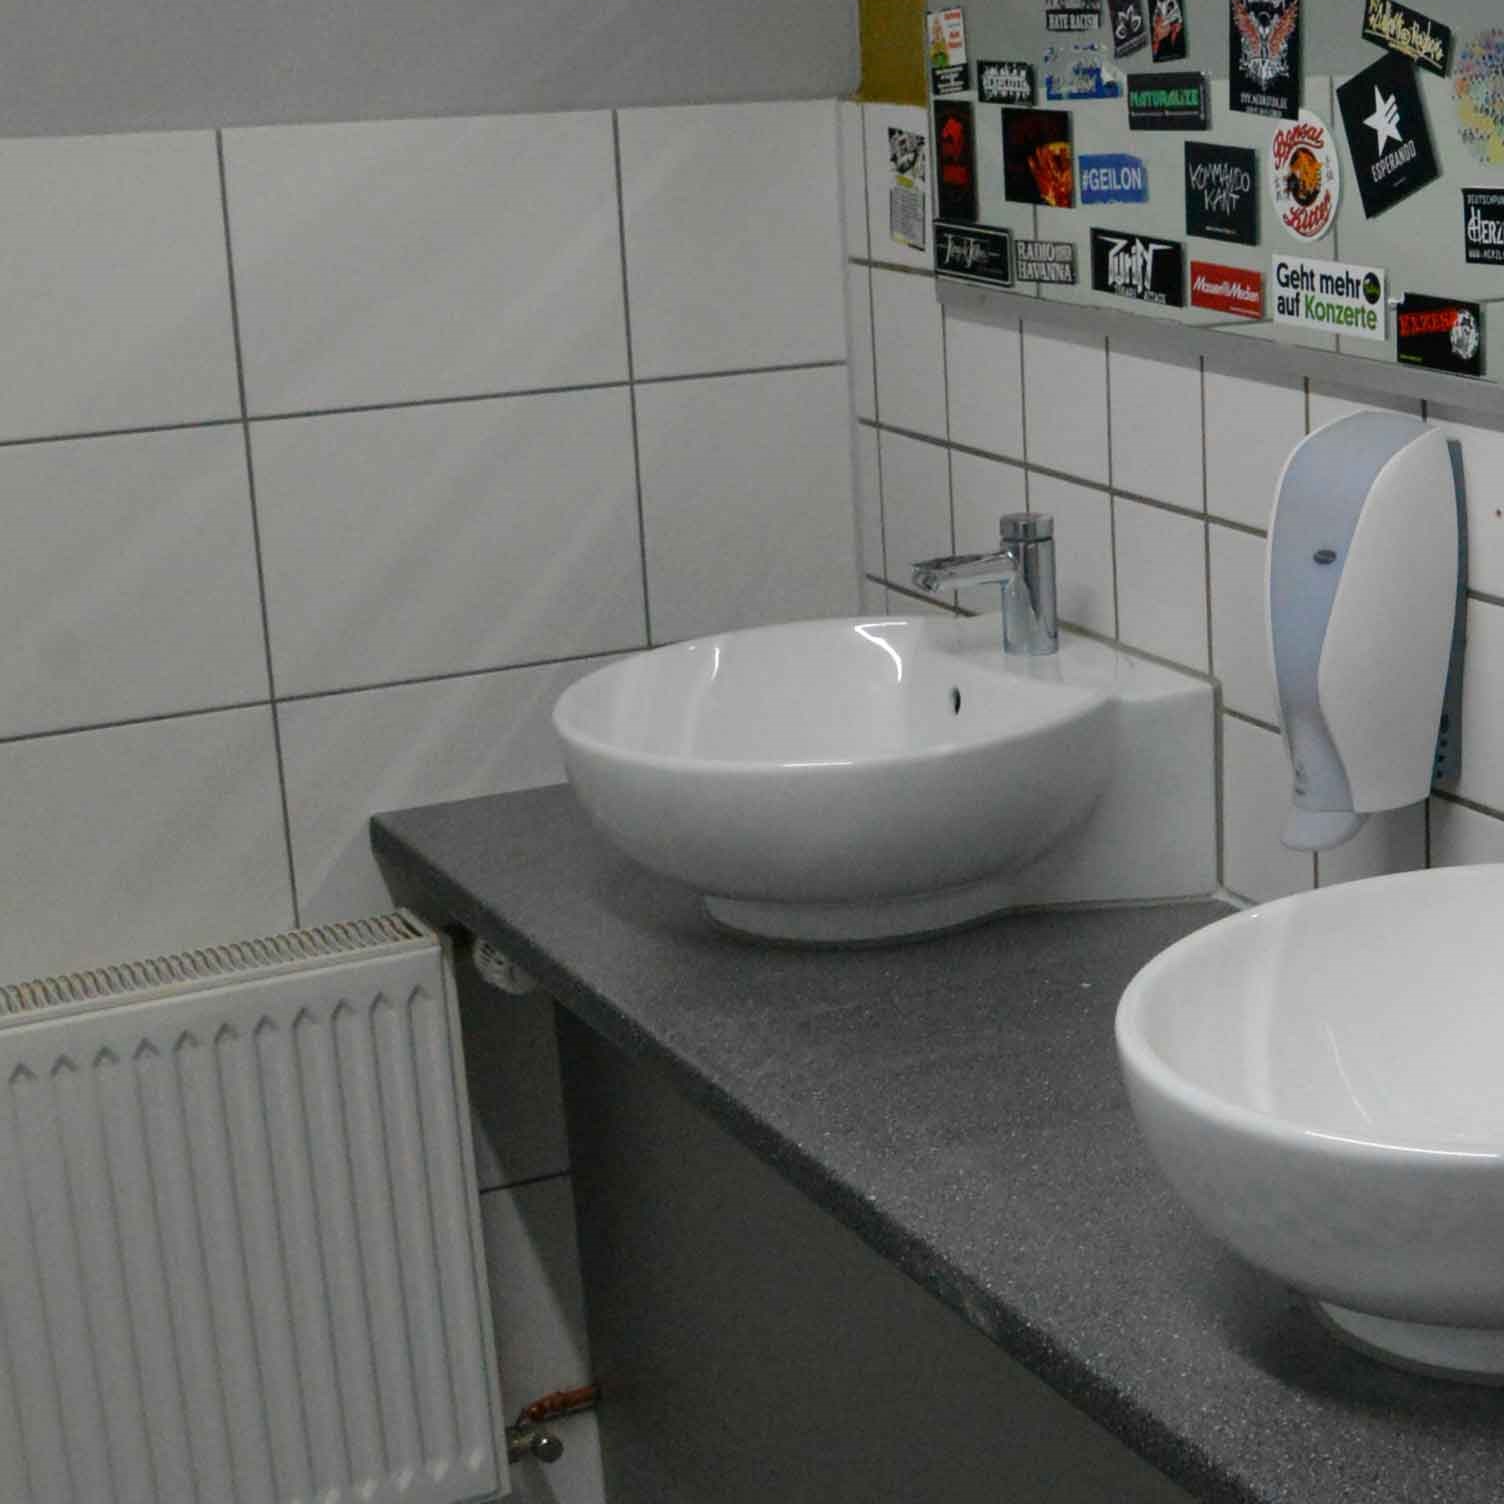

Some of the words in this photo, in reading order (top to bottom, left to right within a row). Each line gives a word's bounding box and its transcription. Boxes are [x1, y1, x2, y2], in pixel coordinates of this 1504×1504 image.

[1370, 140, 1417, 184] ESPERANDO
[1081, 166, 1143, 194] #GEILON
[1017, 241, 1054, 262] RADIO
[1017, 260, 1073, 282] HAVANNA
[1276, 262, 1315, 292] Geht
[1319, 272, 1363, 298] mehr
[1276, 295, 1302, 318] auf
[1304, 295, 1378, 331] Konzerte
